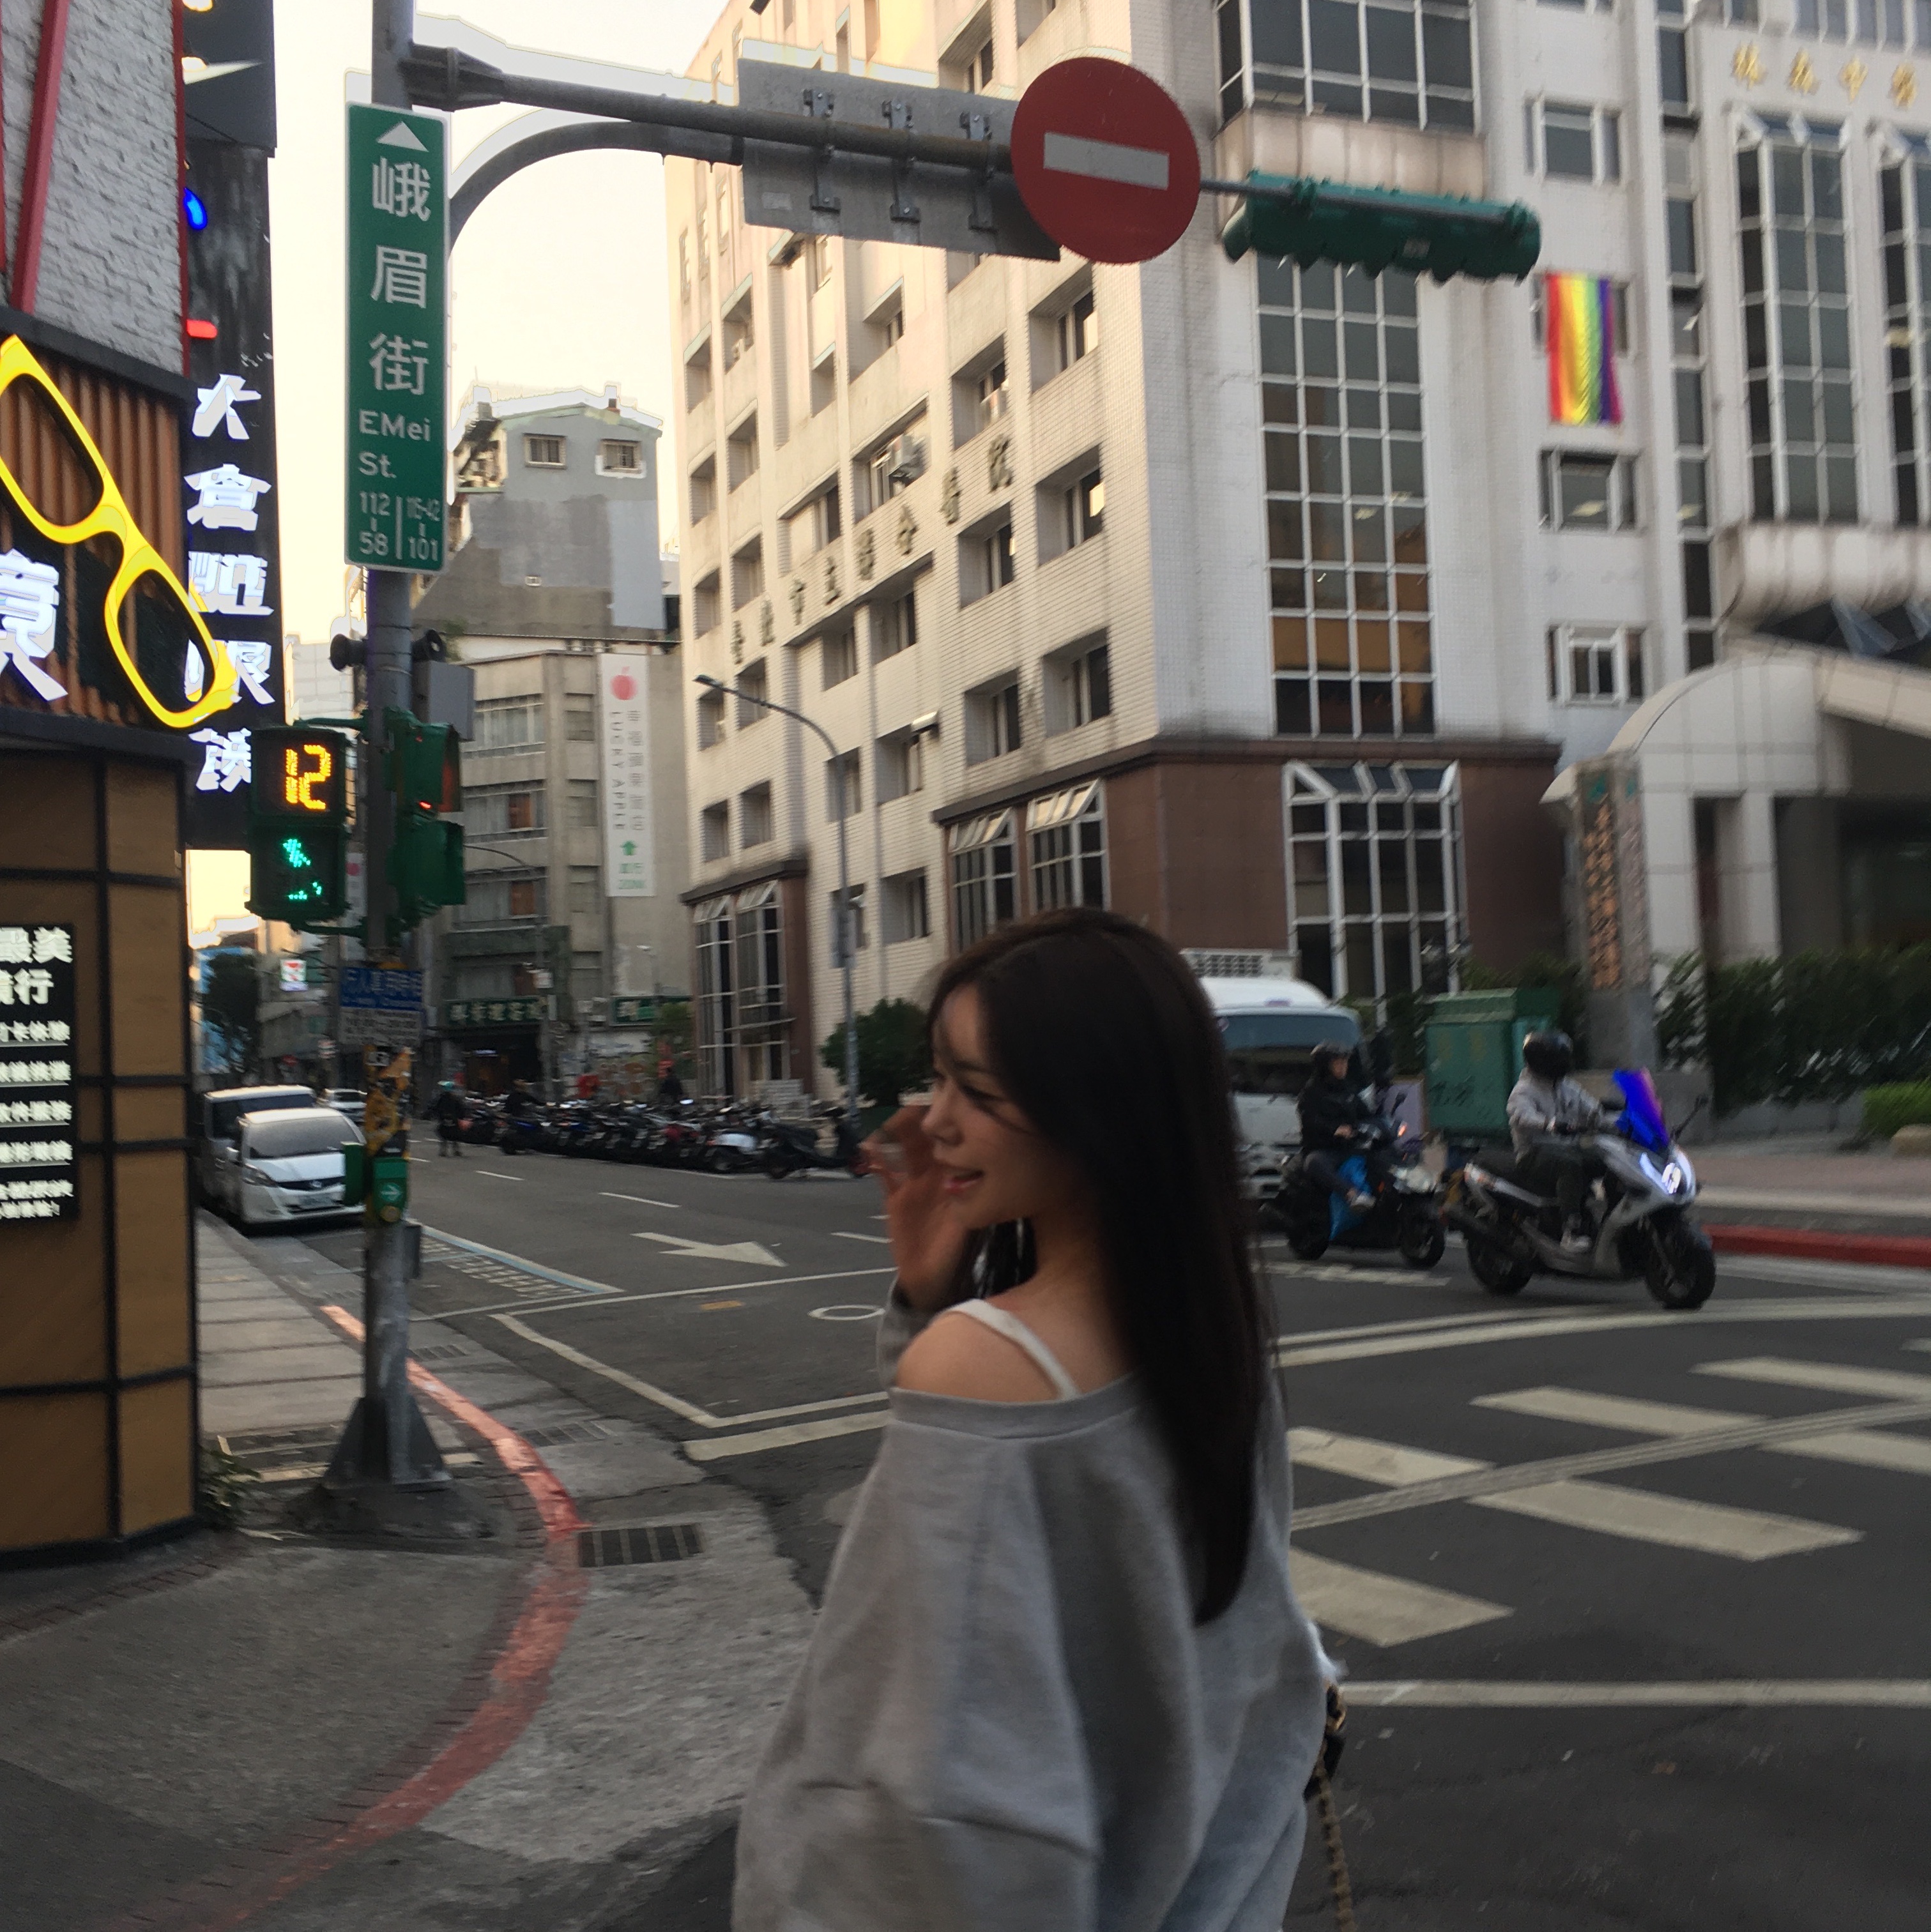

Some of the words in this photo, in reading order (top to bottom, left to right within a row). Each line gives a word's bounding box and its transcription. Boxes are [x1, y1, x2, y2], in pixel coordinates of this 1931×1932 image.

[369, 156, 431, 395] 峨眉街
[359, 409, 431, 441] EMei
[358, 452, 397, 478] St.
[360, 491, 390, 516] 112
[359, 531, 389, 556] 58
[408, 536, 439, 561] 101
[286, 745, 332, 810] 12
